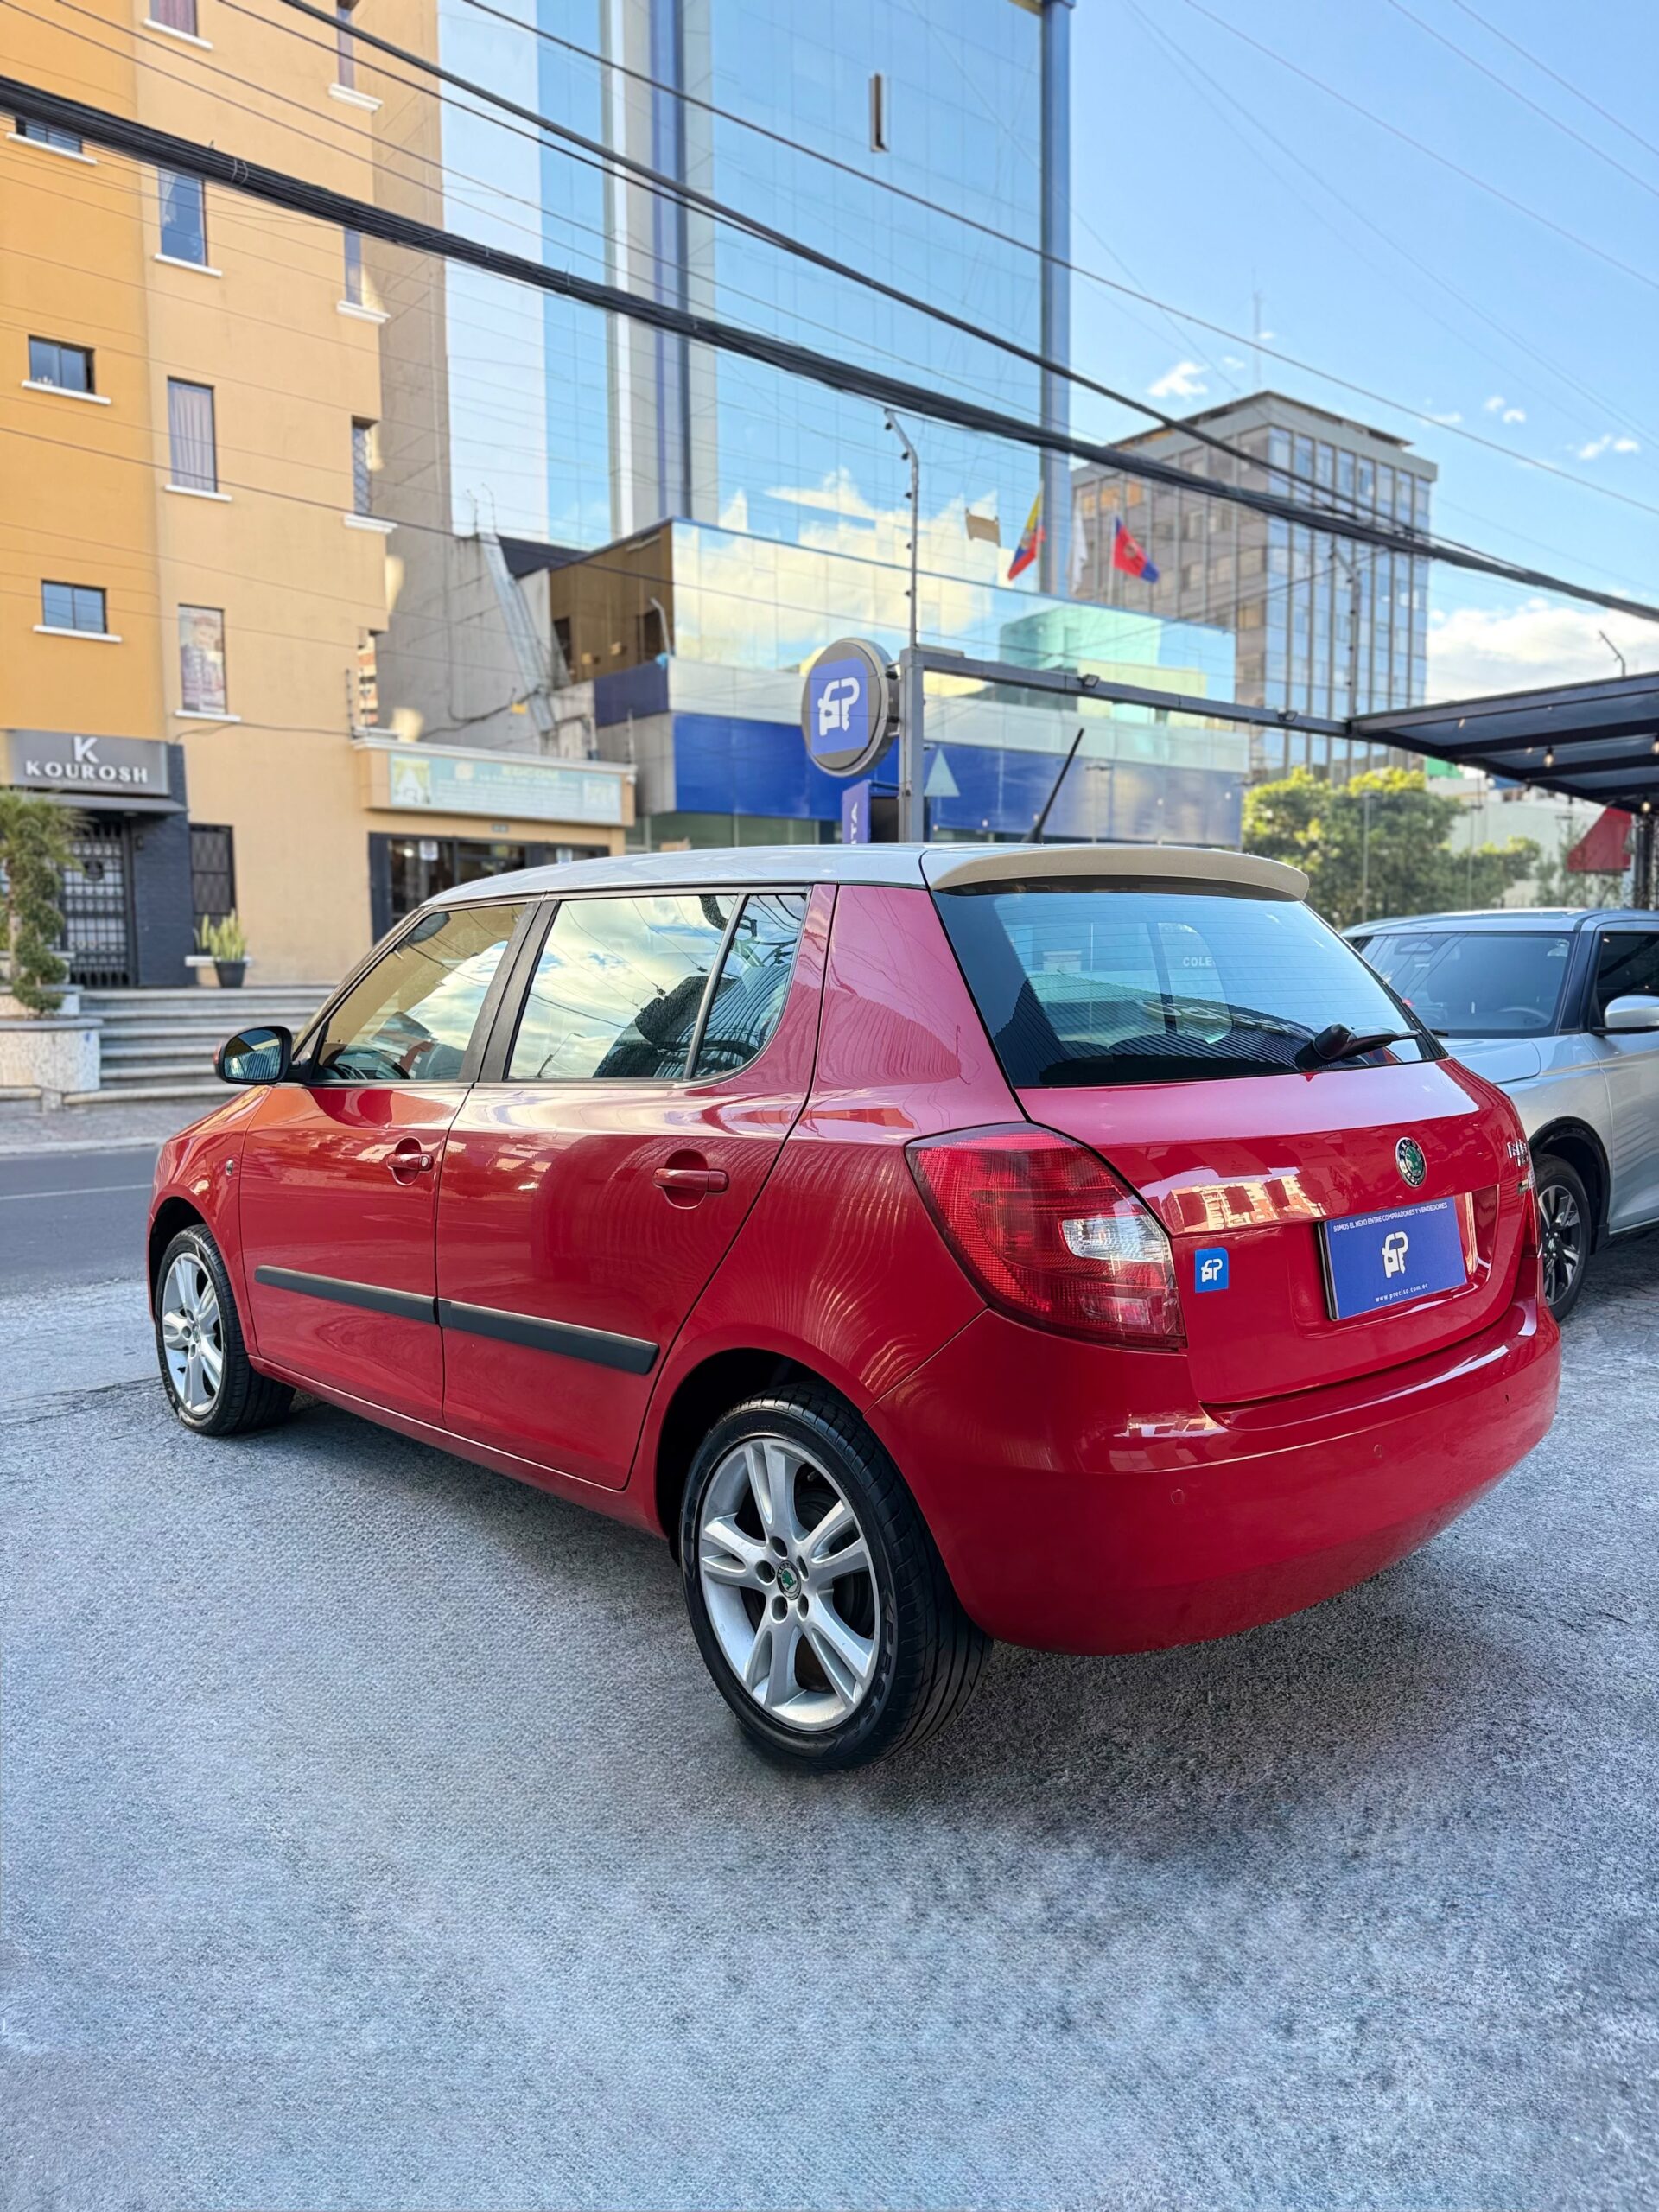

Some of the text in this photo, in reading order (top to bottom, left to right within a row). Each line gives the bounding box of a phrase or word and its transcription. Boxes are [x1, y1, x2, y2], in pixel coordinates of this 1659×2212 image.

[73, 735, 99, 764] K
[26, 760, 148, 784] KOUROSH
[1333, 1223, 1350, 1232] SOMOS
[1355, 1218, 1368, 1228] NEXO
[1368, 1215, 1382, 1225] ENTRE
[1382, 1209, 1415, 1222] COMPRADORES
[1418, 1202, 1448, 1214] VENDEDORES
[1375, 1283, 1428, 1302] www.preciso.com.ec
